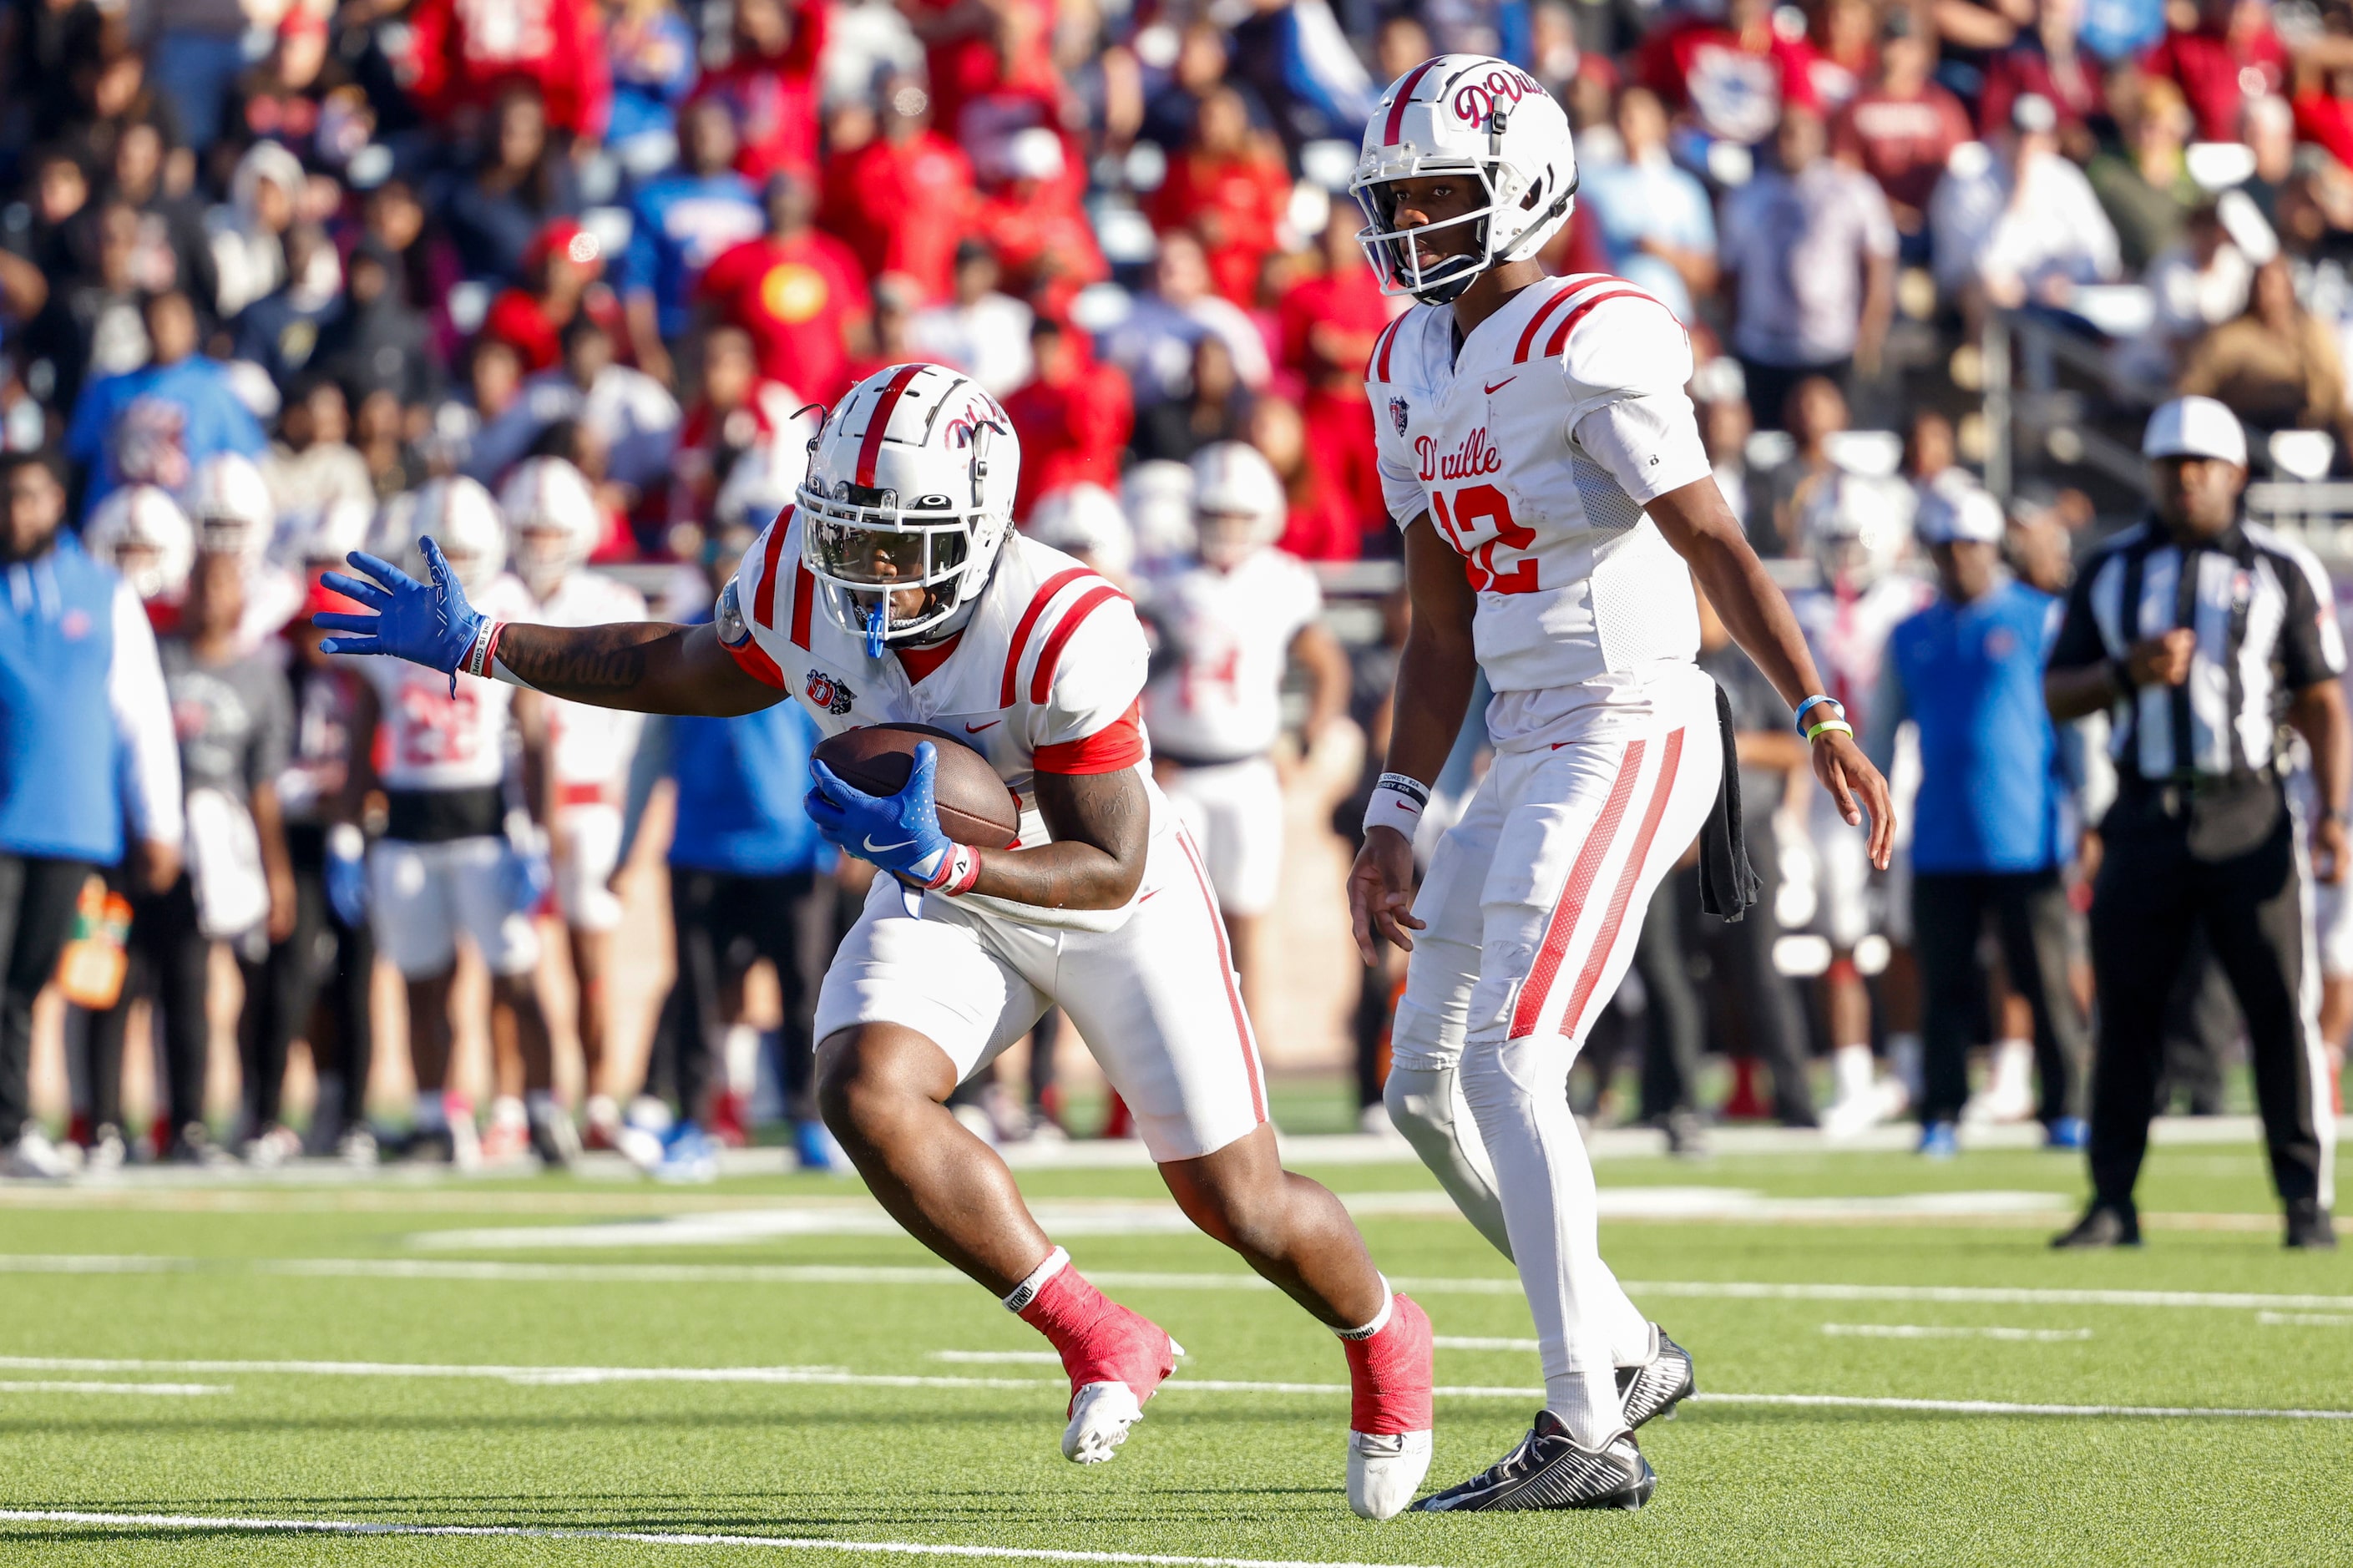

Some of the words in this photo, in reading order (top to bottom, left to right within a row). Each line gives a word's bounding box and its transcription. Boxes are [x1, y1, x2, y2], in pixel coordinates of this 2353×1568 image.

[1433, 483, 1539, 594] 12
[478, 636, 487, 645] IS
[1384, 774, 1406, 782] COREY
